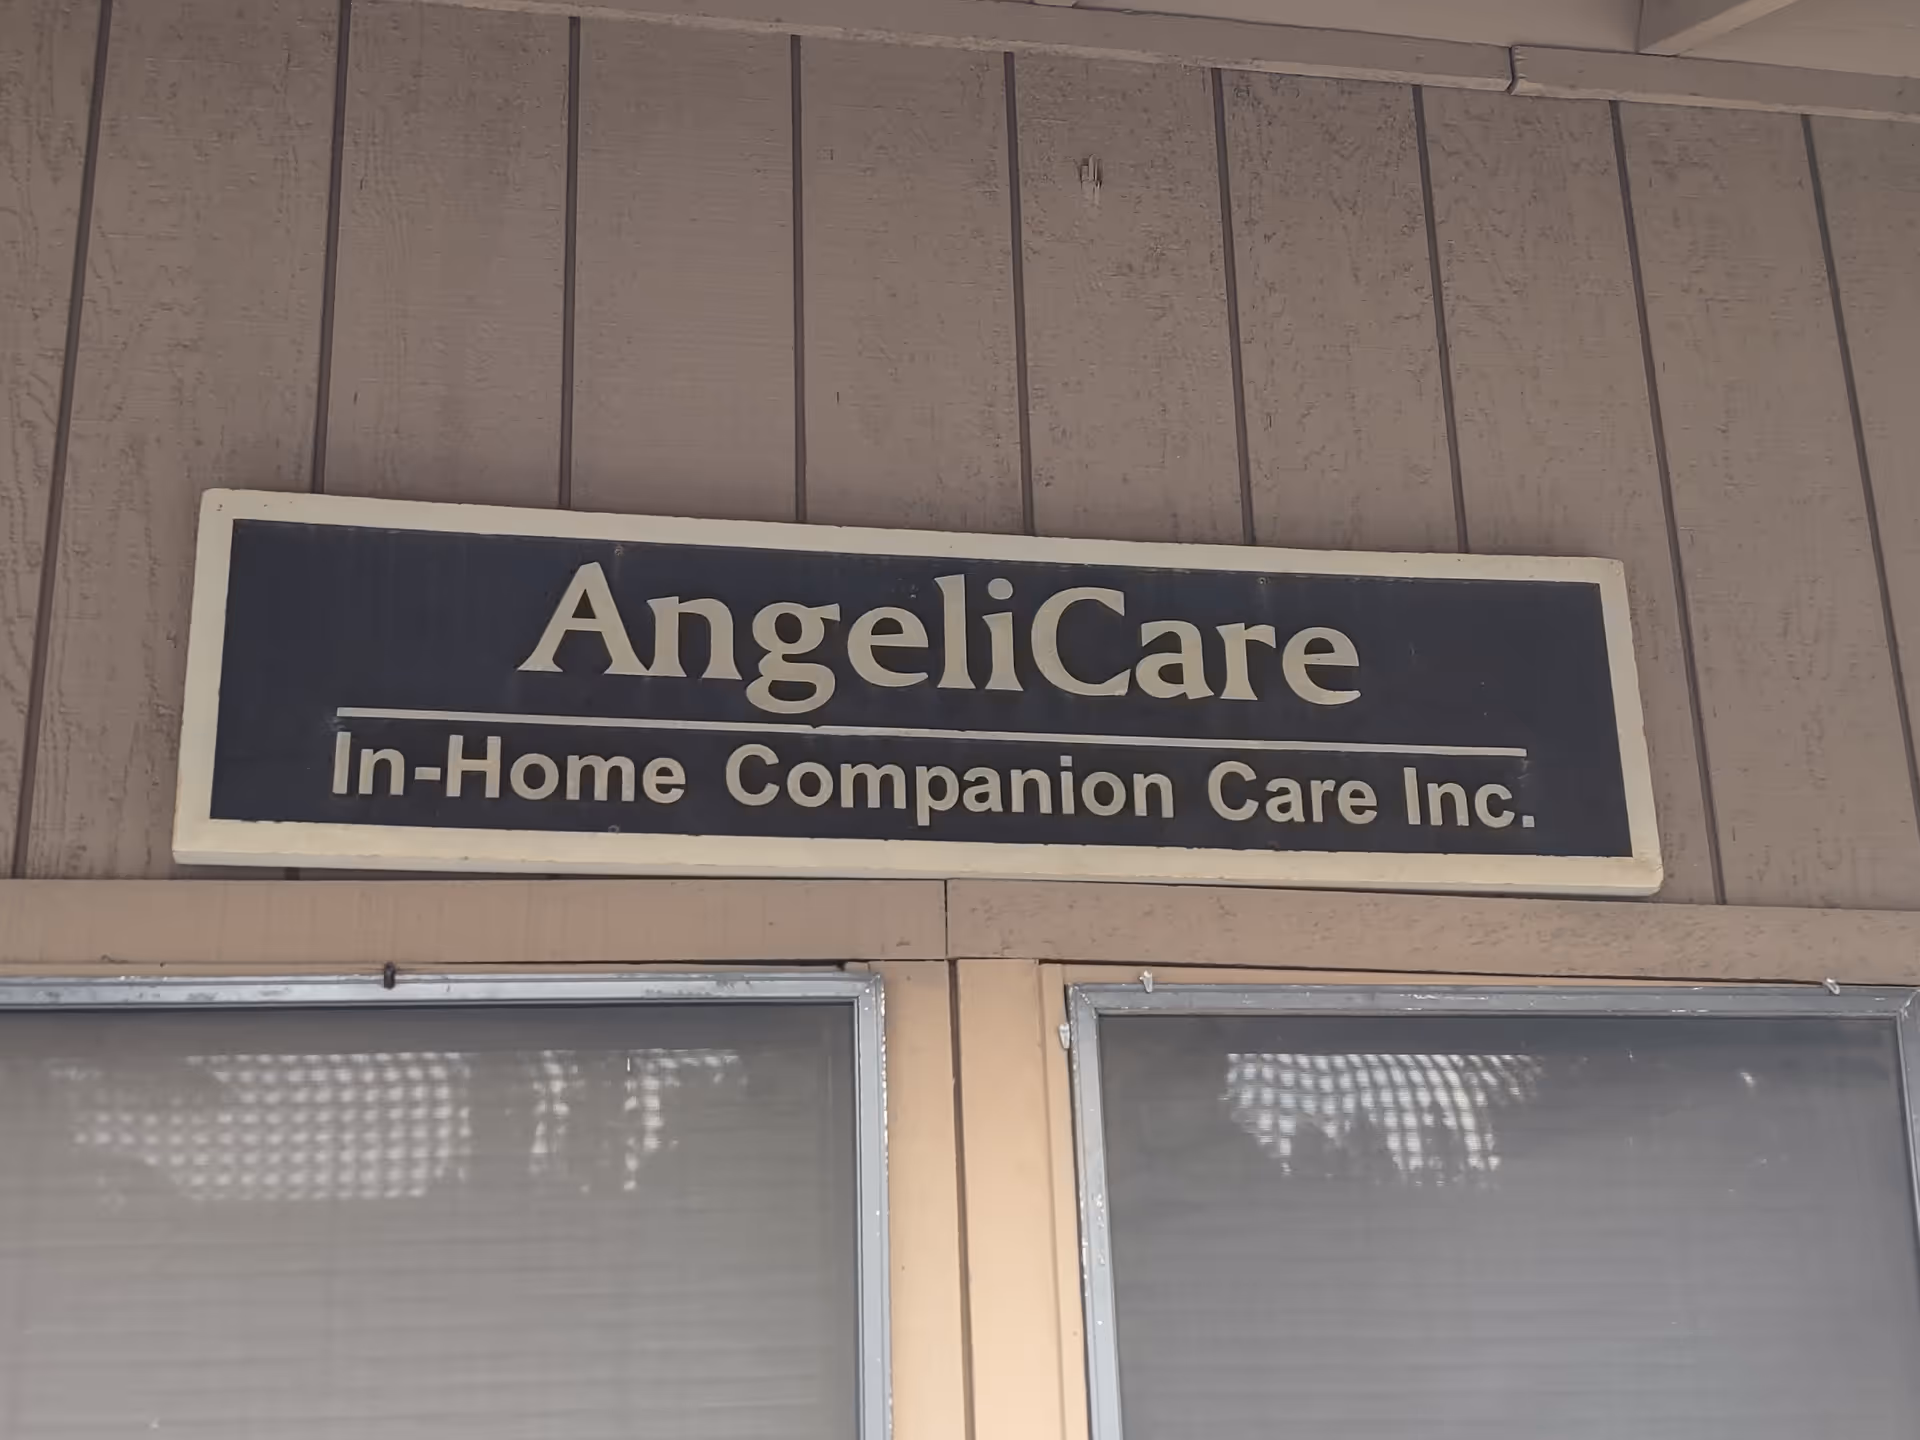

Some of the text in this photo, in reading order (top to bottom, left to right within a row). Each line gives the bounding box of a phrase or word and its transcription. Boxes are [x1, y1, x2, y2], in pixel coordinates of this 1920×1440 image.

[517, 561, 1362, 715] AngeliCare
[332, 731, 1535, 829] In-Home Companion Care Inc.
